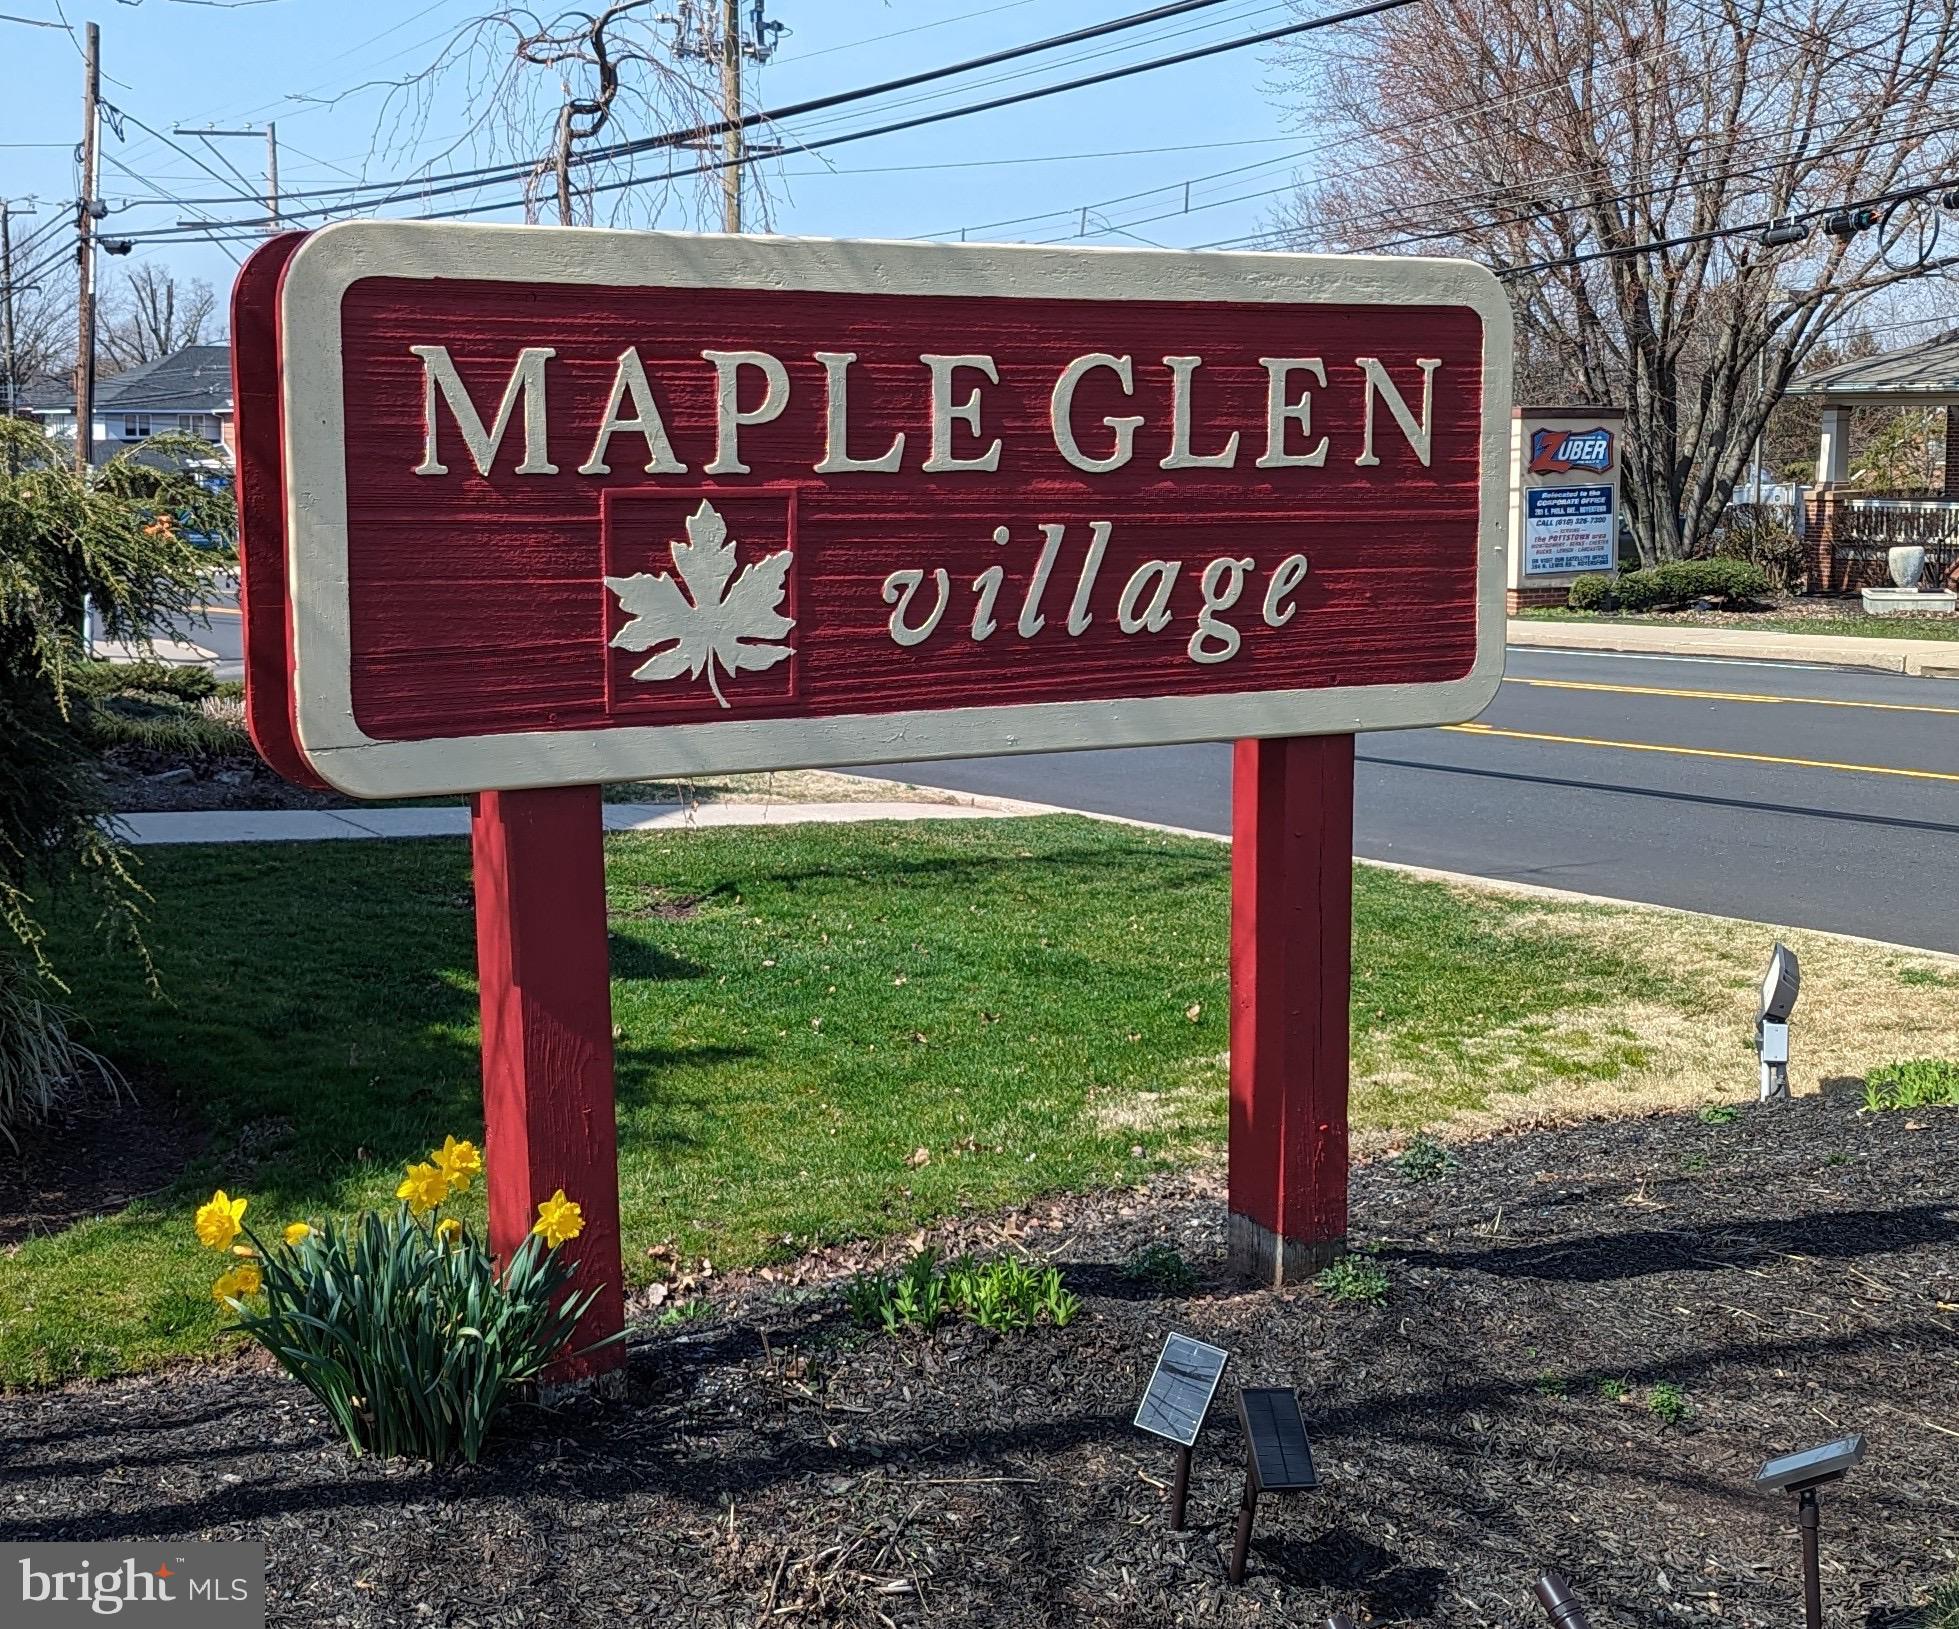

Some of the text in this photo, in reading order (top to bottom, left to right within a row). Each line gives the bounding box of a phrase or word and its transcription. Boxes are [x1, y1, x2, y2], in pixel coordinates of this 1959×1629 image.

[409, 345, 1442, 476] MAPLE GLEN
[1529, 432, 1608, 473] ZUBER
[1536, 499, 1580, 507] CORPORATE
[1536, 519, 1554, 527] CALL
[1548, 534, 1590, 542] POTTSTOWN
[882, 521, 1308, 664] village
